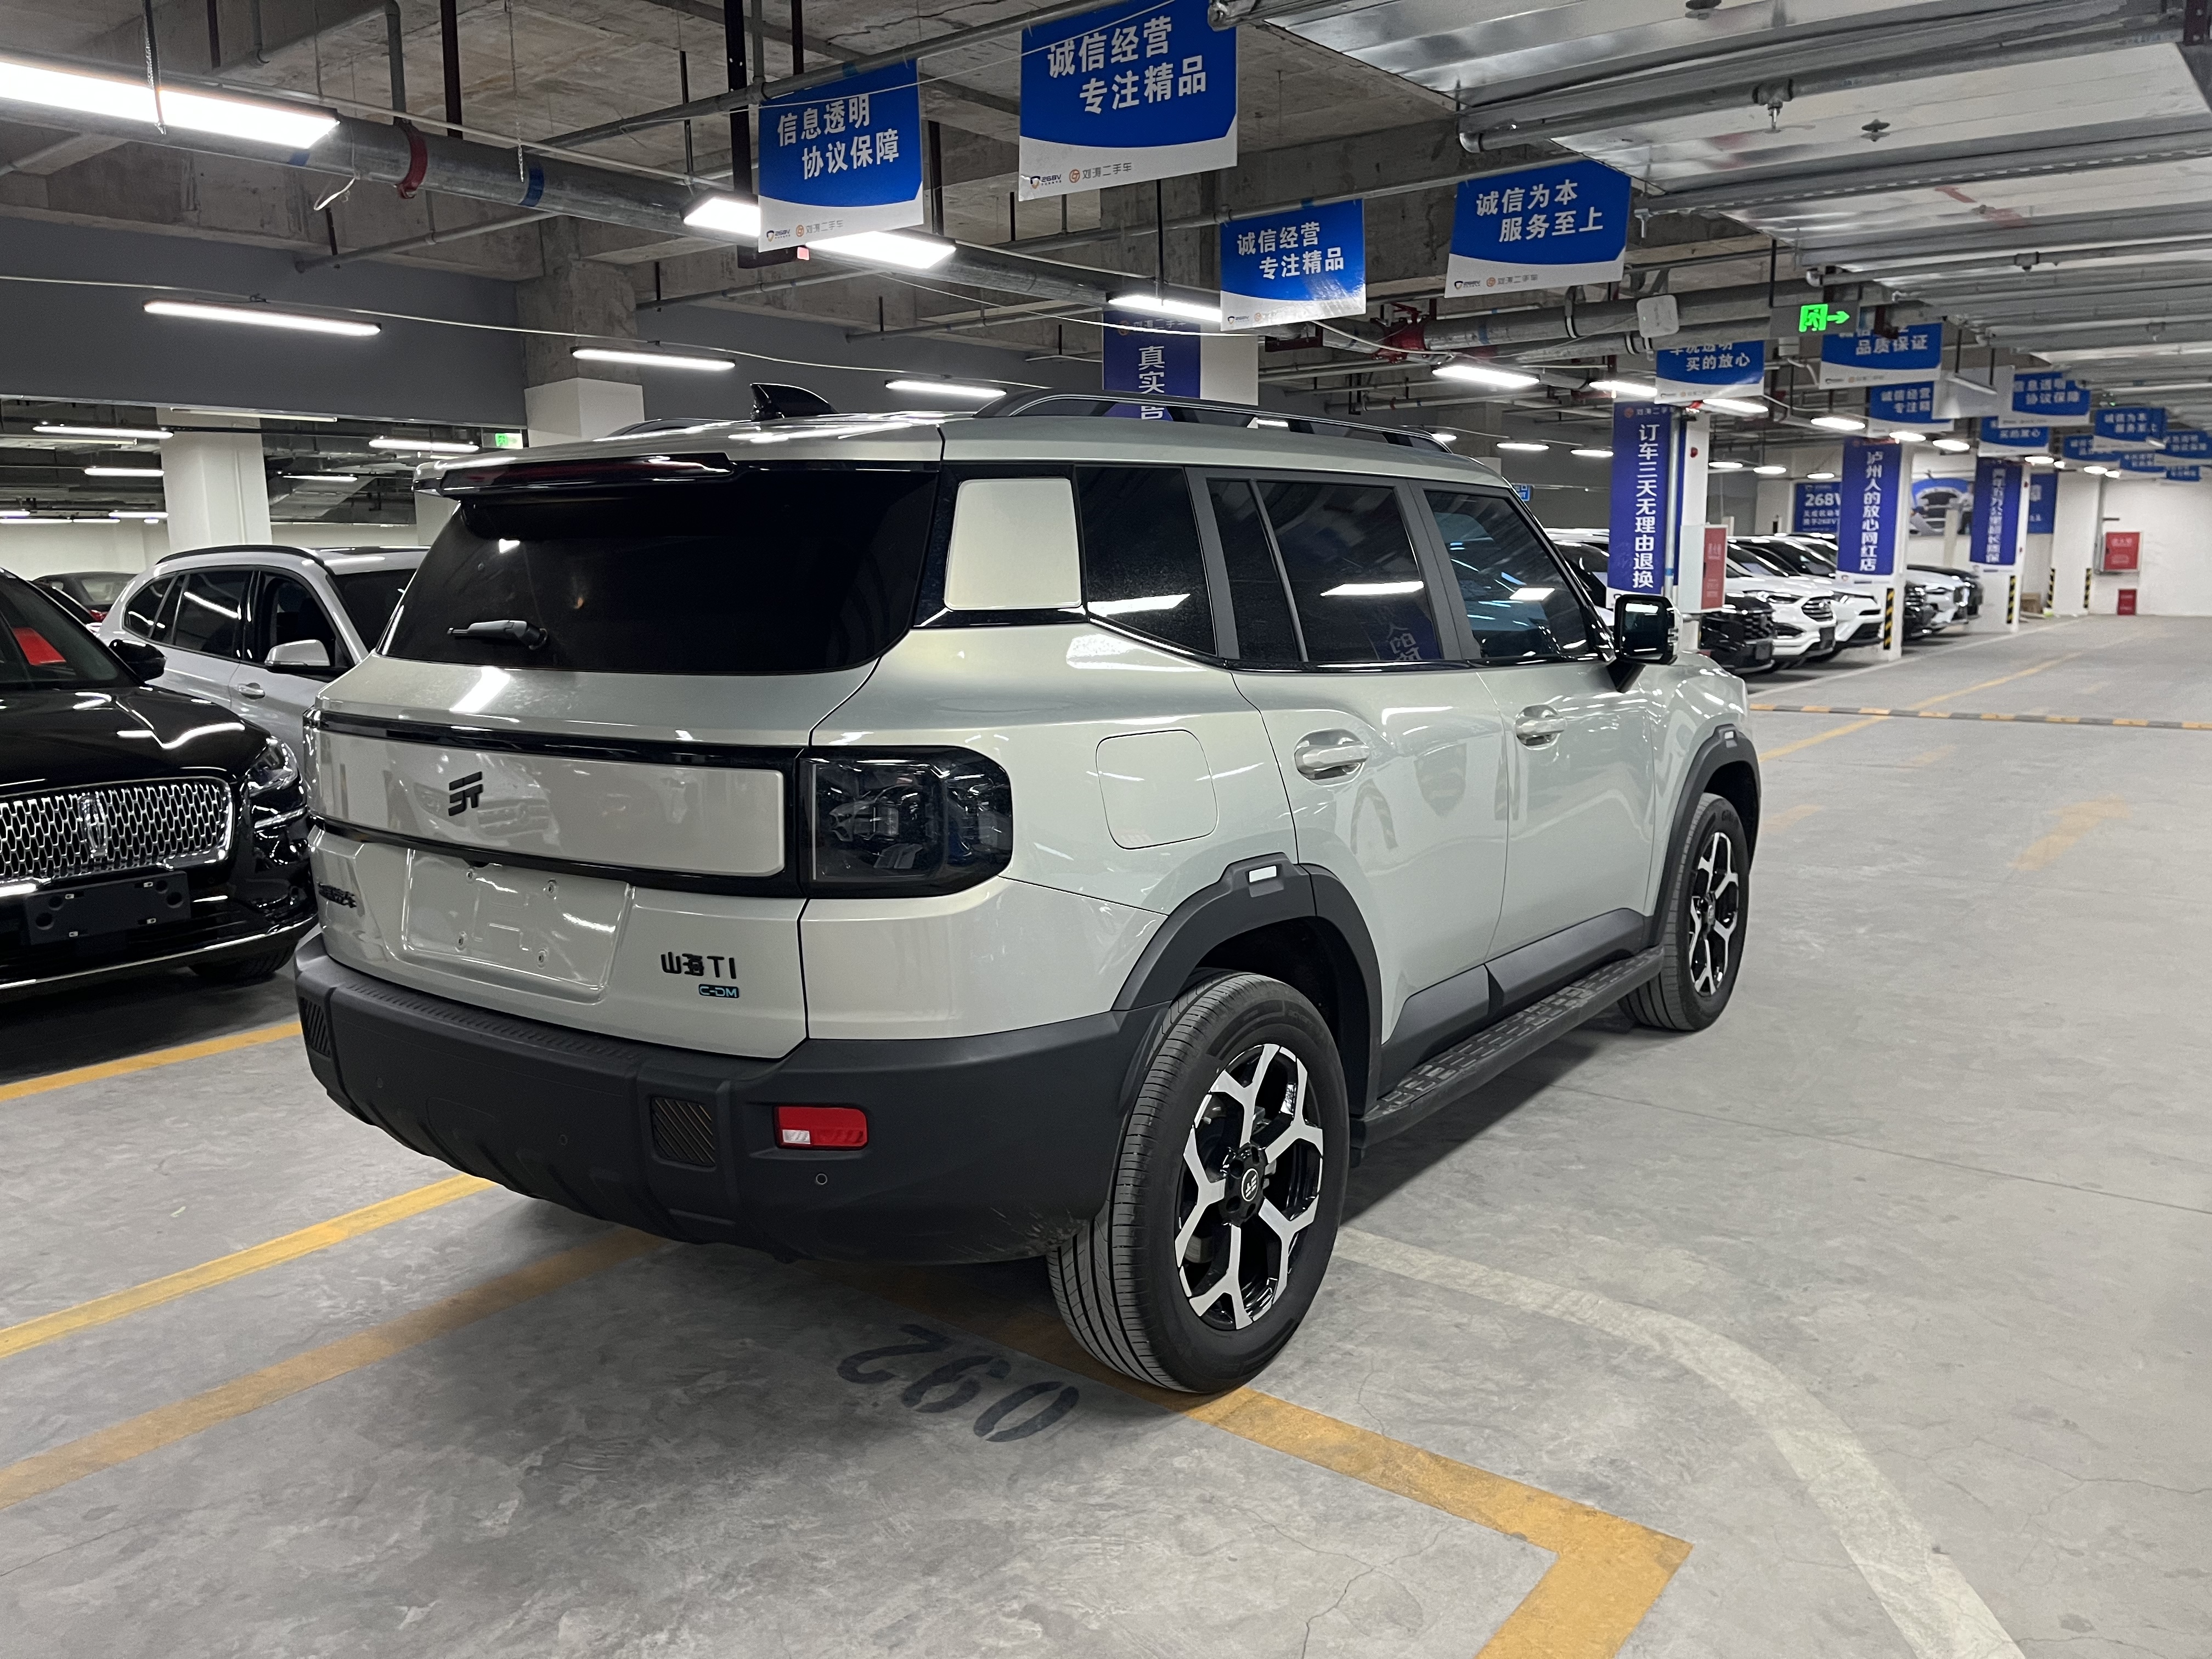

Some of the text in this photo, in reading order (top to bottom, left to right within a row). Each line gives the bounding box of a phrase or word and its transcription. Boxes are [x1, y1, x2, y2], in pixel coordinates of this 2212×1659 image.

[1047, 15, 1172, 78] 诚信经营
[1079, 54, 1206, 115] 专注精品
[777, 94, 870, 147] 信息透明
[802, 128, 899, 180] 协议保障
[1476, 179, 1578, 217] 诚信为本
[1237, 221, 1320, 256] 诚信经营
[1499, 206, 1604, 242] 服务至上
[1259, 247, 1344, 280] 专注精品
[1686, 352, 1751, 371] 买的放心
[1855, 334, 1928, 356] 品质保证
[1633, 424, 1660, 589] 订车三天无理由退换
[699, 986, 737, 998] C-DM
